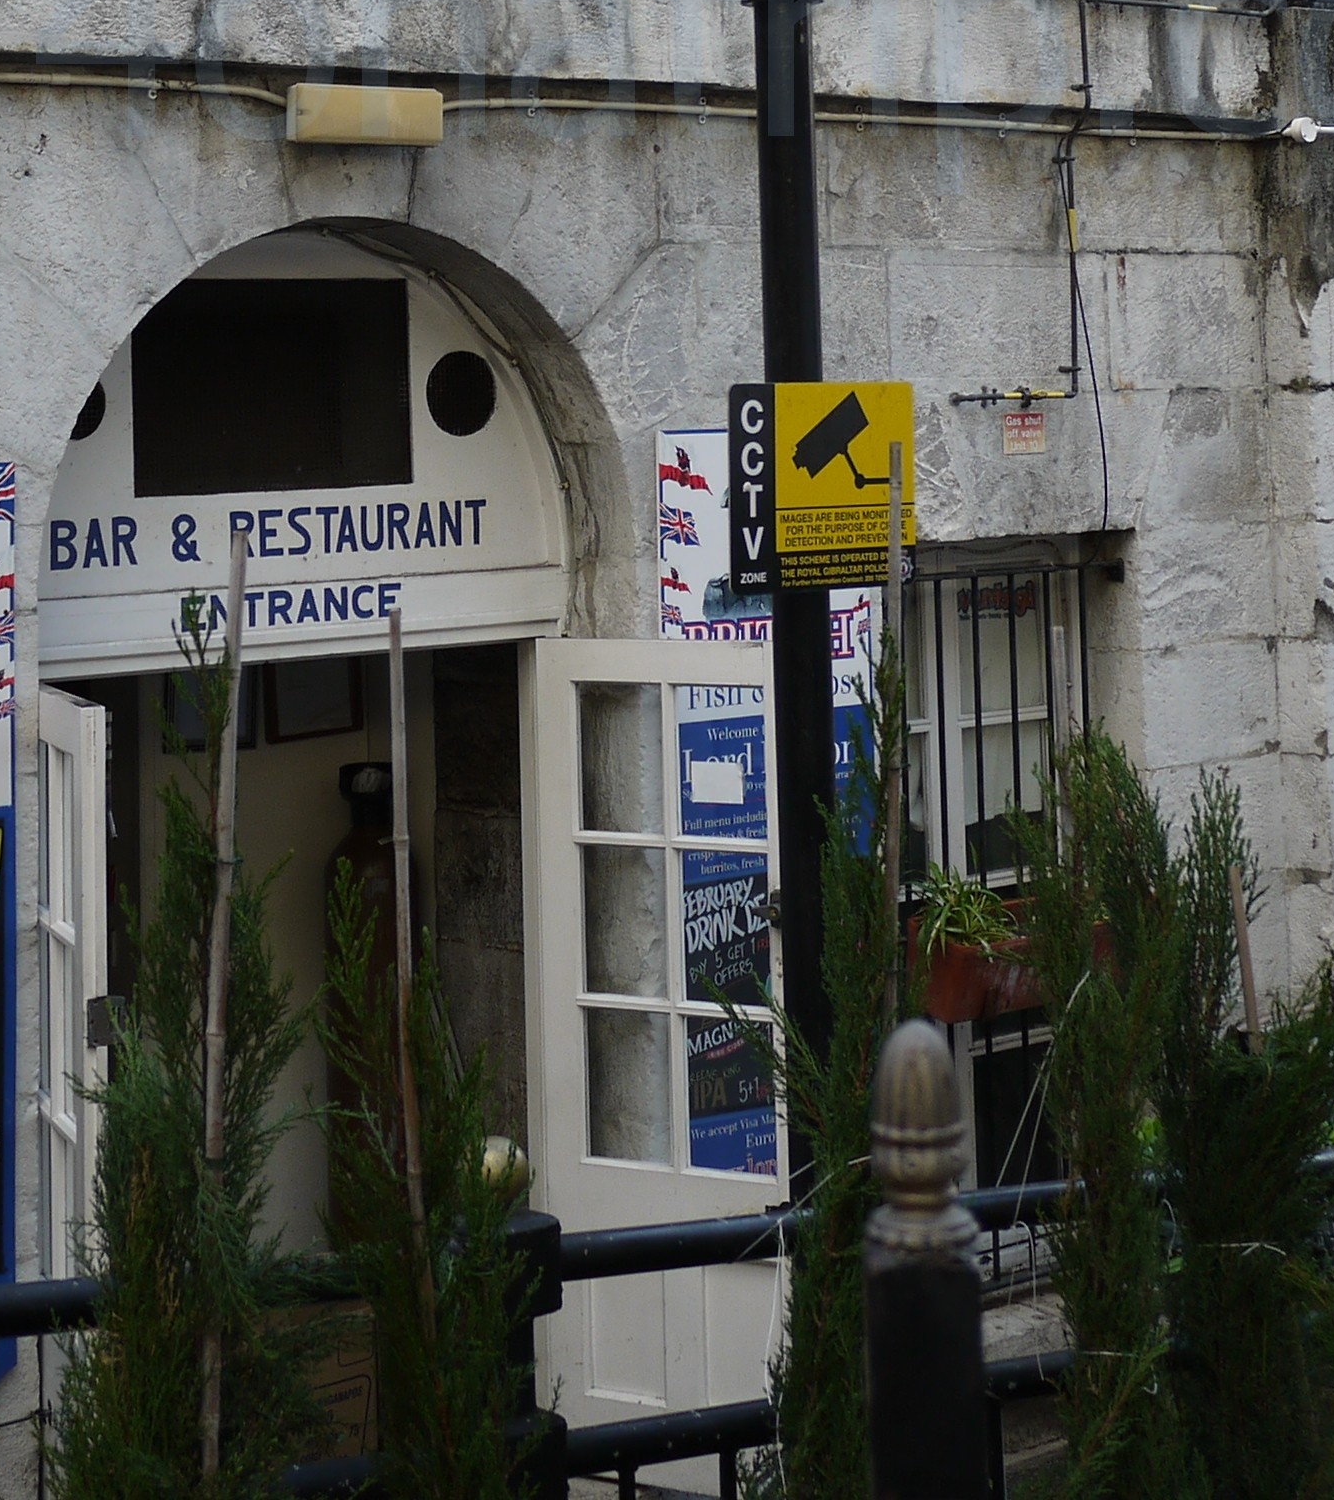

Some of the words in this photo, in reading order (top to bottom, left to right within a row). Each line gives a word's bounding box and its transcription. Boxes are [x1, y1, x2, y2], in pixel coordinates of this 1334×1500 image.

[1005, 415, 1022, 426] Gas
[1024, 415, 1041, 426] shut
[740, 399, 765, 561] CCTV
[780, 513, 813, 524] IMAGES
[815, 512, 834, 522] ARE
[835, 511, 860, 522] BEING
[862, 508, 913, 520] MONITED
[49, 515, 139, 571] BAR
[171, 512, 201, 563] &
[229, 498, 488, 561] RESTAURANT
[786, 525, 804, 536] FOR
[806, 524, 823, 535] THE
[825, 522, 865, 534] PURPOSE
[867, 521, 878, 532] OF
[880, 520, 907, 531] CRE
[785, 536, 834, 548] DETECTION
[836, 534, 854, 545] AND
[855, 532, 907, 544] PREVENN
[780, 556, 798, 567] THIS
[799, 554, 831, 566] SCHEME
[832, 554, 840, 564] IS
[841, 552, 879, 564] OPERATED
[739, 571, 767, 585] ZONE
[781, 569, 796, 579] THE
[797, 567, 822, 578] ROYAL
[823, 565, 864, 576] GIBRALTAR
[181, 582, 403, 633] ENTRANCE
[707, 726, 759, 741] Welcome
[682, 742, 754, 784] Ld
[684, 818, 702, 831] Full
[705, 817, 731, 829] menu
[741, 855, 765, 869] fresh
[682, 876, 754, 920] FEBRUARY
[686, 906, 746, 954] DRINK
[714, 950, 723, 969] 5
[727, 941, 746, 960] GET
[750, 936, 756, 955] 1
[713, 957, 754, 987] OFFERS
[693, 1077, 727, 1110] IPA
[691, 1128, 706, 1140] We
[708, 1122, 738, 1136] accept
[740, 1117, 759, 1130] Visa
